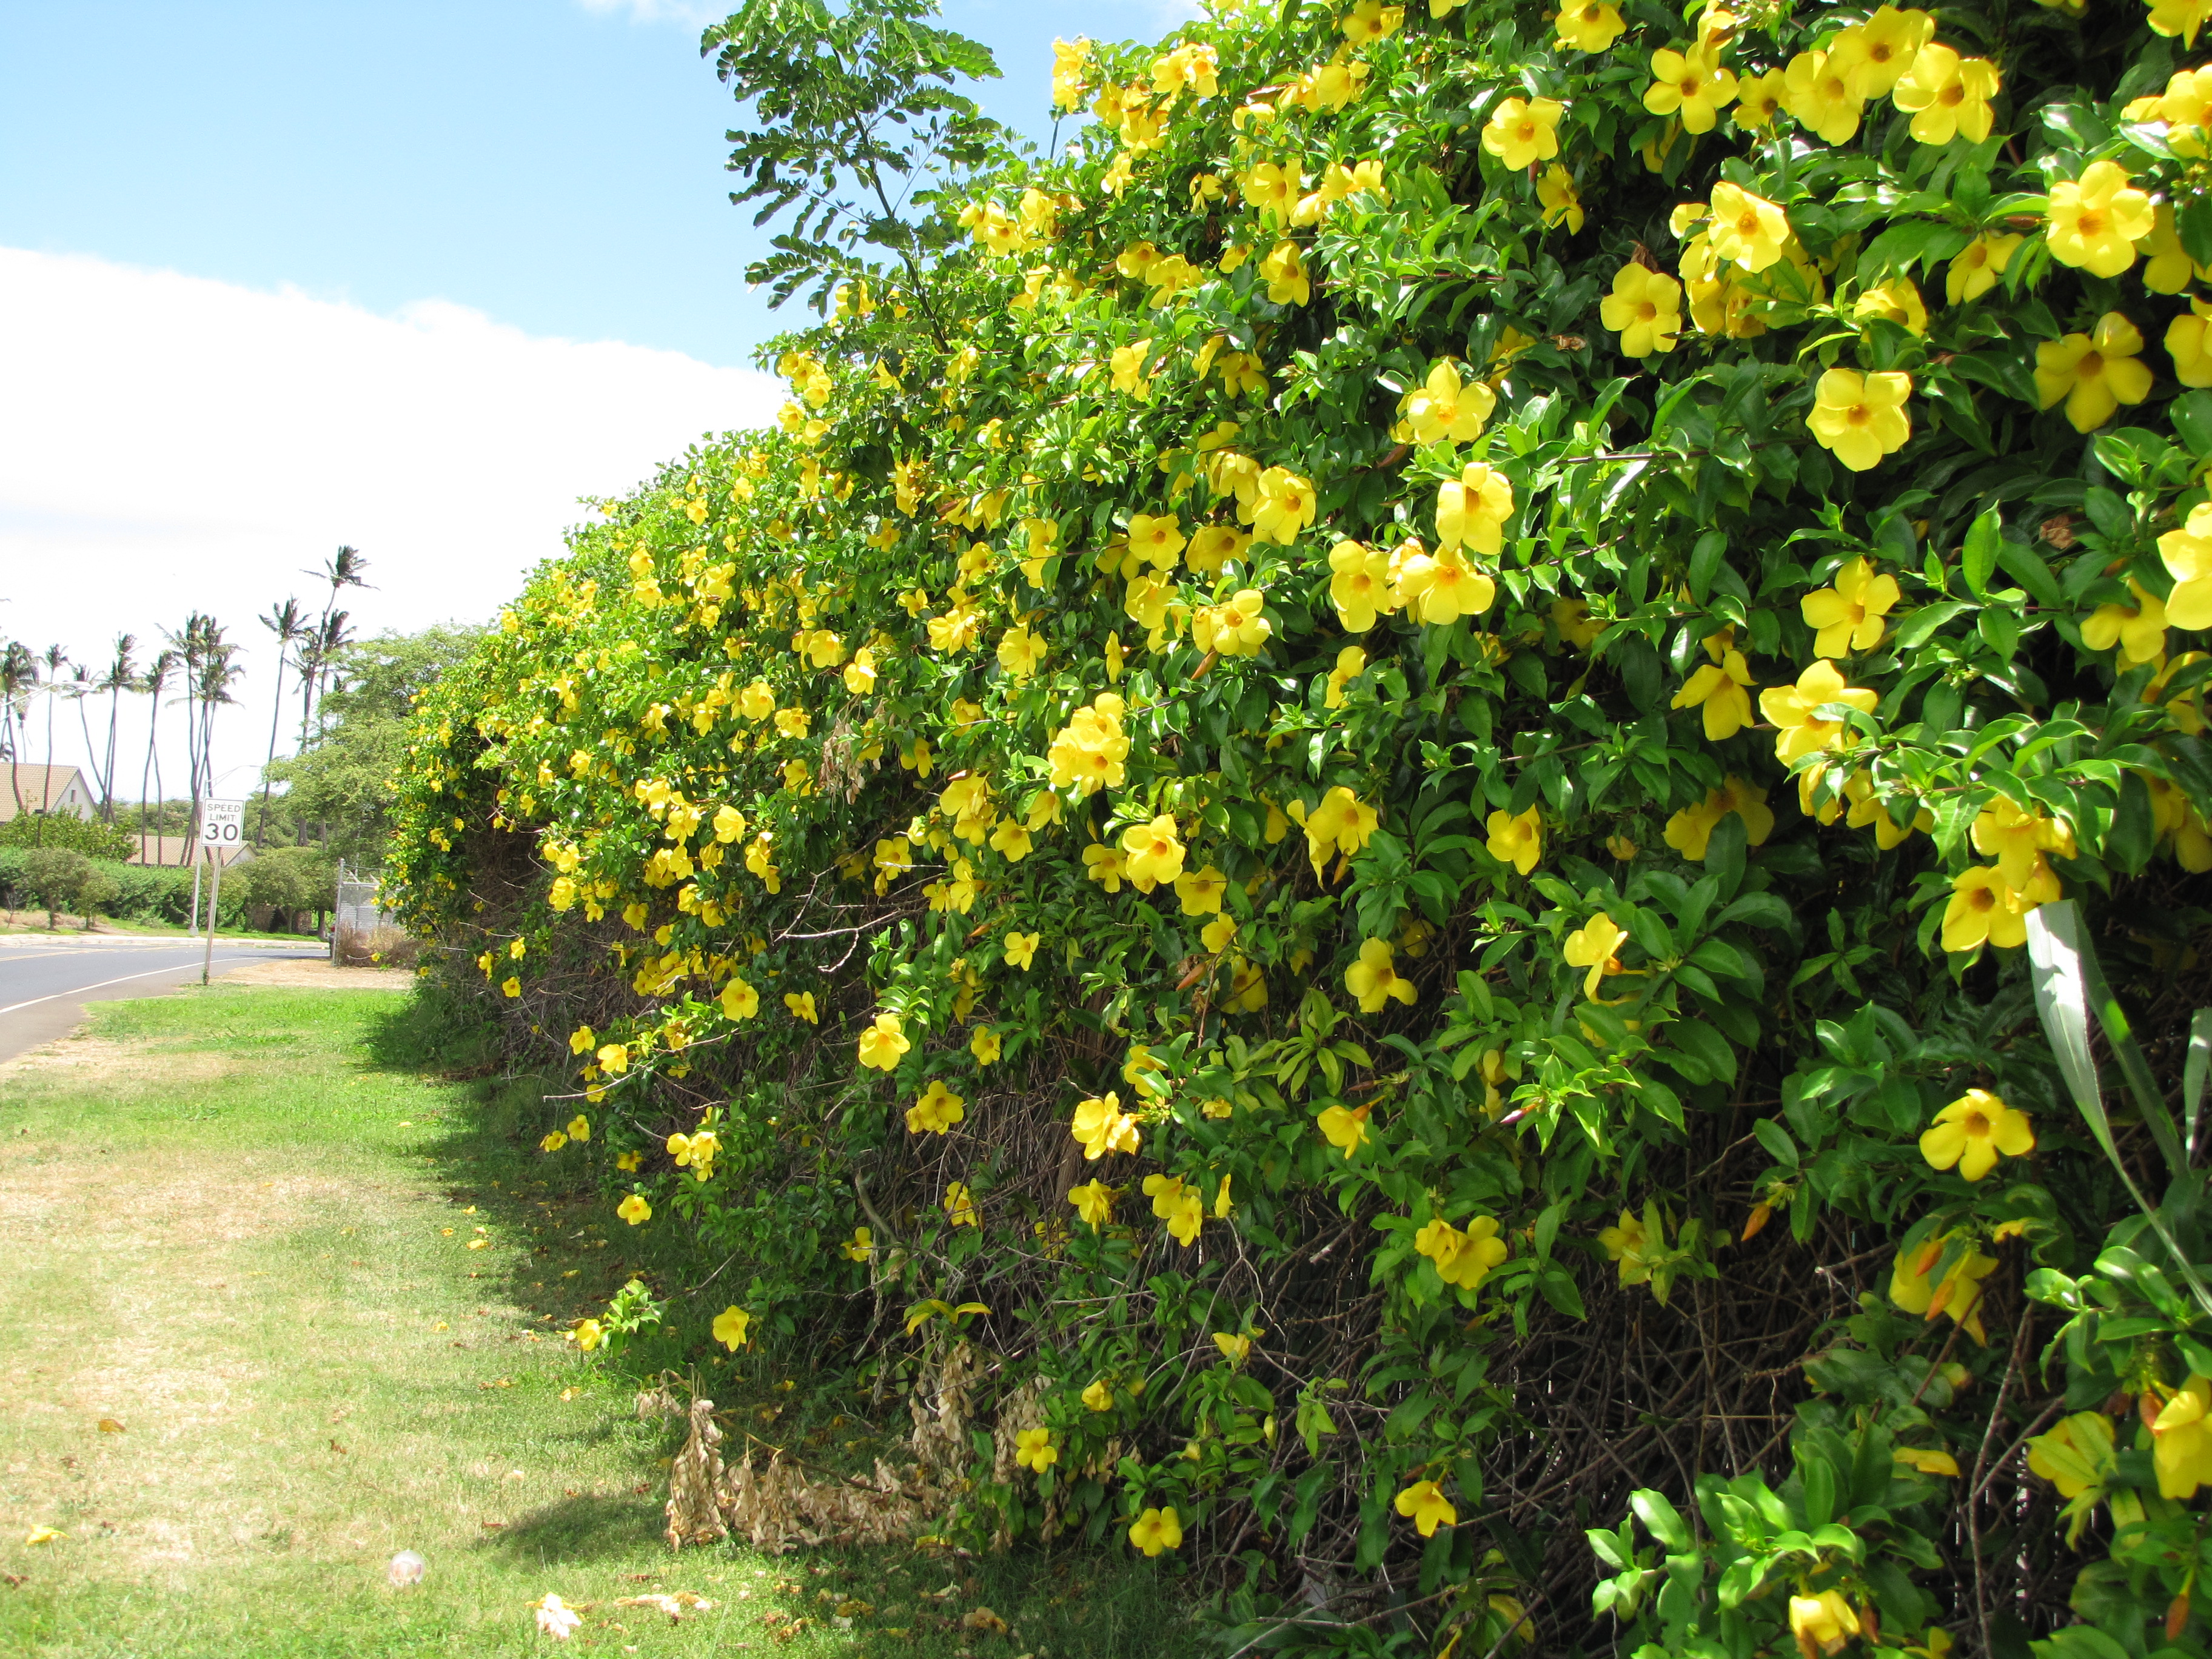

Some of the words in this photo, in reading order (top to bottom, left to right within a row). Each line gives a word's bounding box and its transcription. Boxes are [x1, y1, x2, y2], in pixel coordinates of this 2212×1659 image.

[207, 803, 241, 813] SPEED
[209, 813, 235, 822] LIMIT
[205, 823, 238, 841] 30
